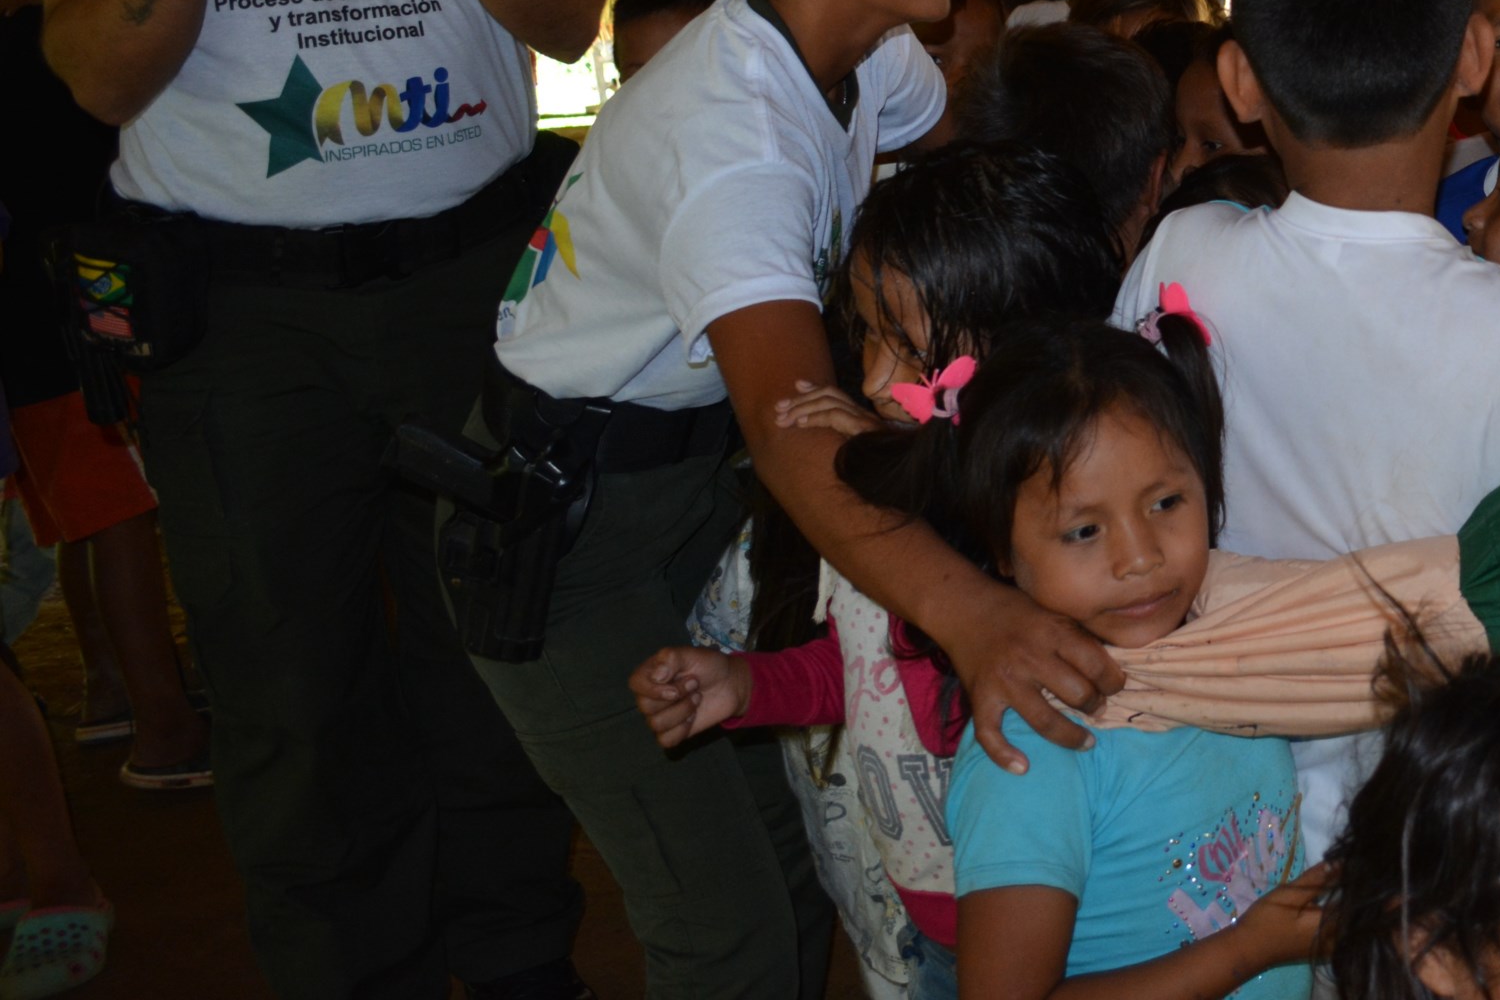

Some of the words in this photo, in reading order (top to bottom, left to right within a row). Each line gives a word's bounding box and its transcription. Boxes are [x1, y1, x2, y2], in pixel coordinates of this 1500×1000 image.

[268, 14, 282, 33] y
[297, 21, 426, 50] Institucional
[323, 137, 423, 164] INSPIRADOS
[426, 135, 446, 150] EN
[447, 124, 483, 145] USTED
